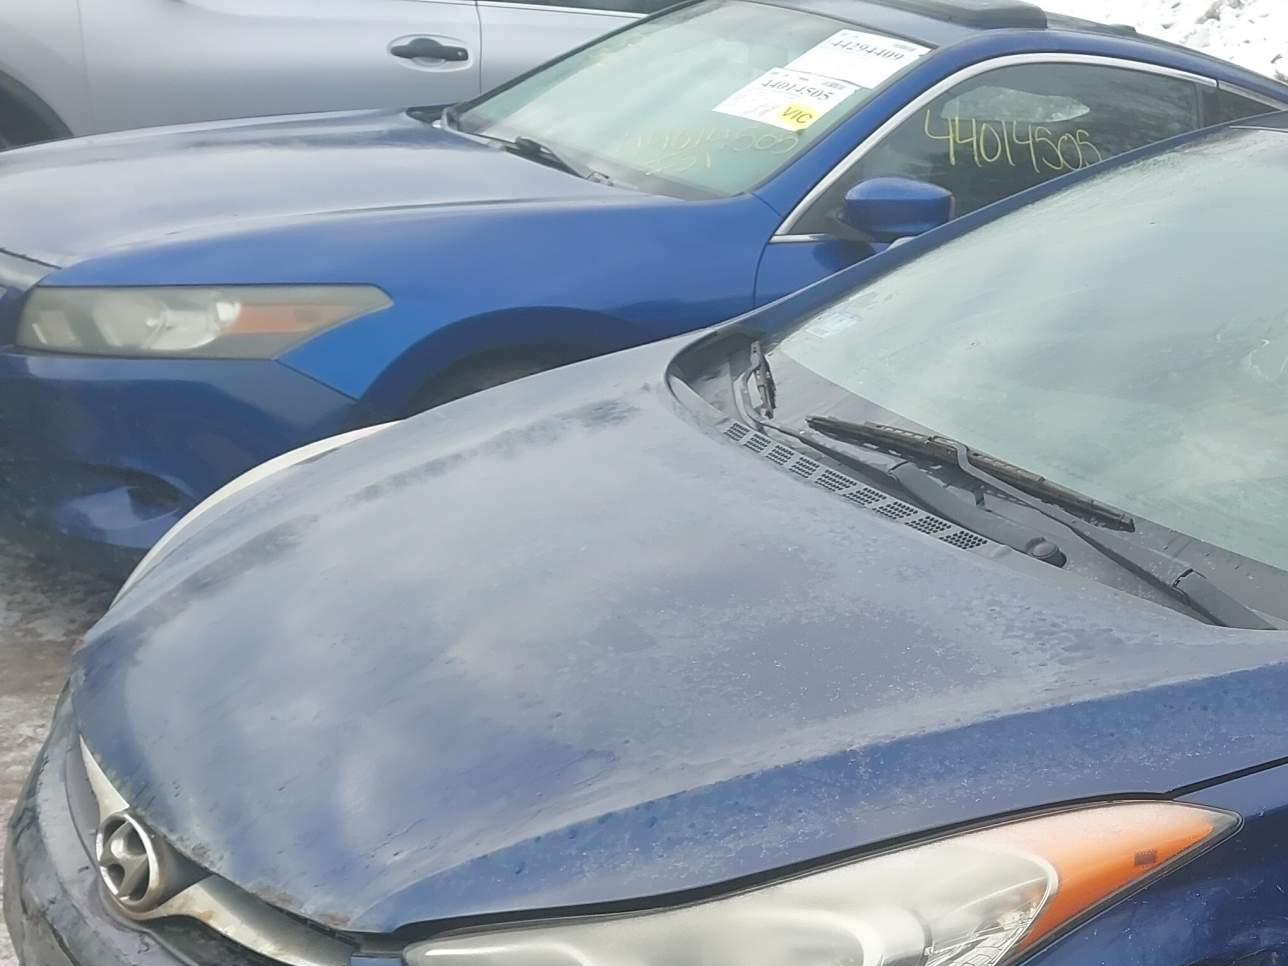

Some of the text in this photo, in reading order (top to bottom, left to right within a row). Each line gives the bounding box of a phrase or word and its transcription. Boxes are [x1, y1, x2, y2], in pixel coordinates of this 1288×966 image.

[761, 79, 835, 100] 44014505
[782, 106, 813, 123] VIC
[922, 108, 1103, 174] 44014505
